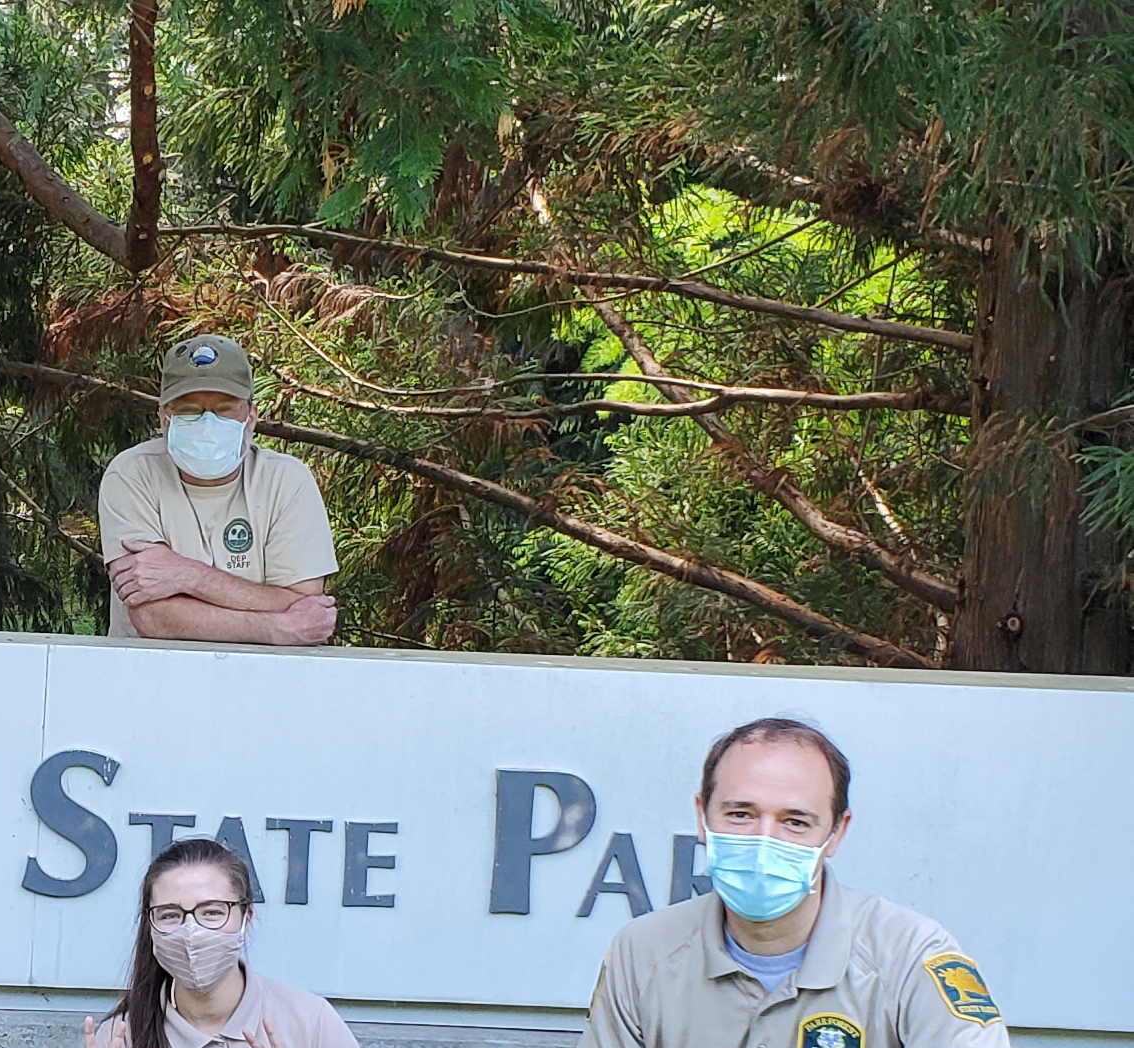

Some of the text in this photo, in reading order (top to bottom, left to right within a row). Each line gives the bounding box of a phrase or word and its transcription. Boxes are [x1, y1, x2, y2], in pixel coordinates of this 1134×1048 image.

[227, 561, 251, 569] STAFF
[21, 748, 399, 909] STATE
[488, 767, 716, 918] PAR
